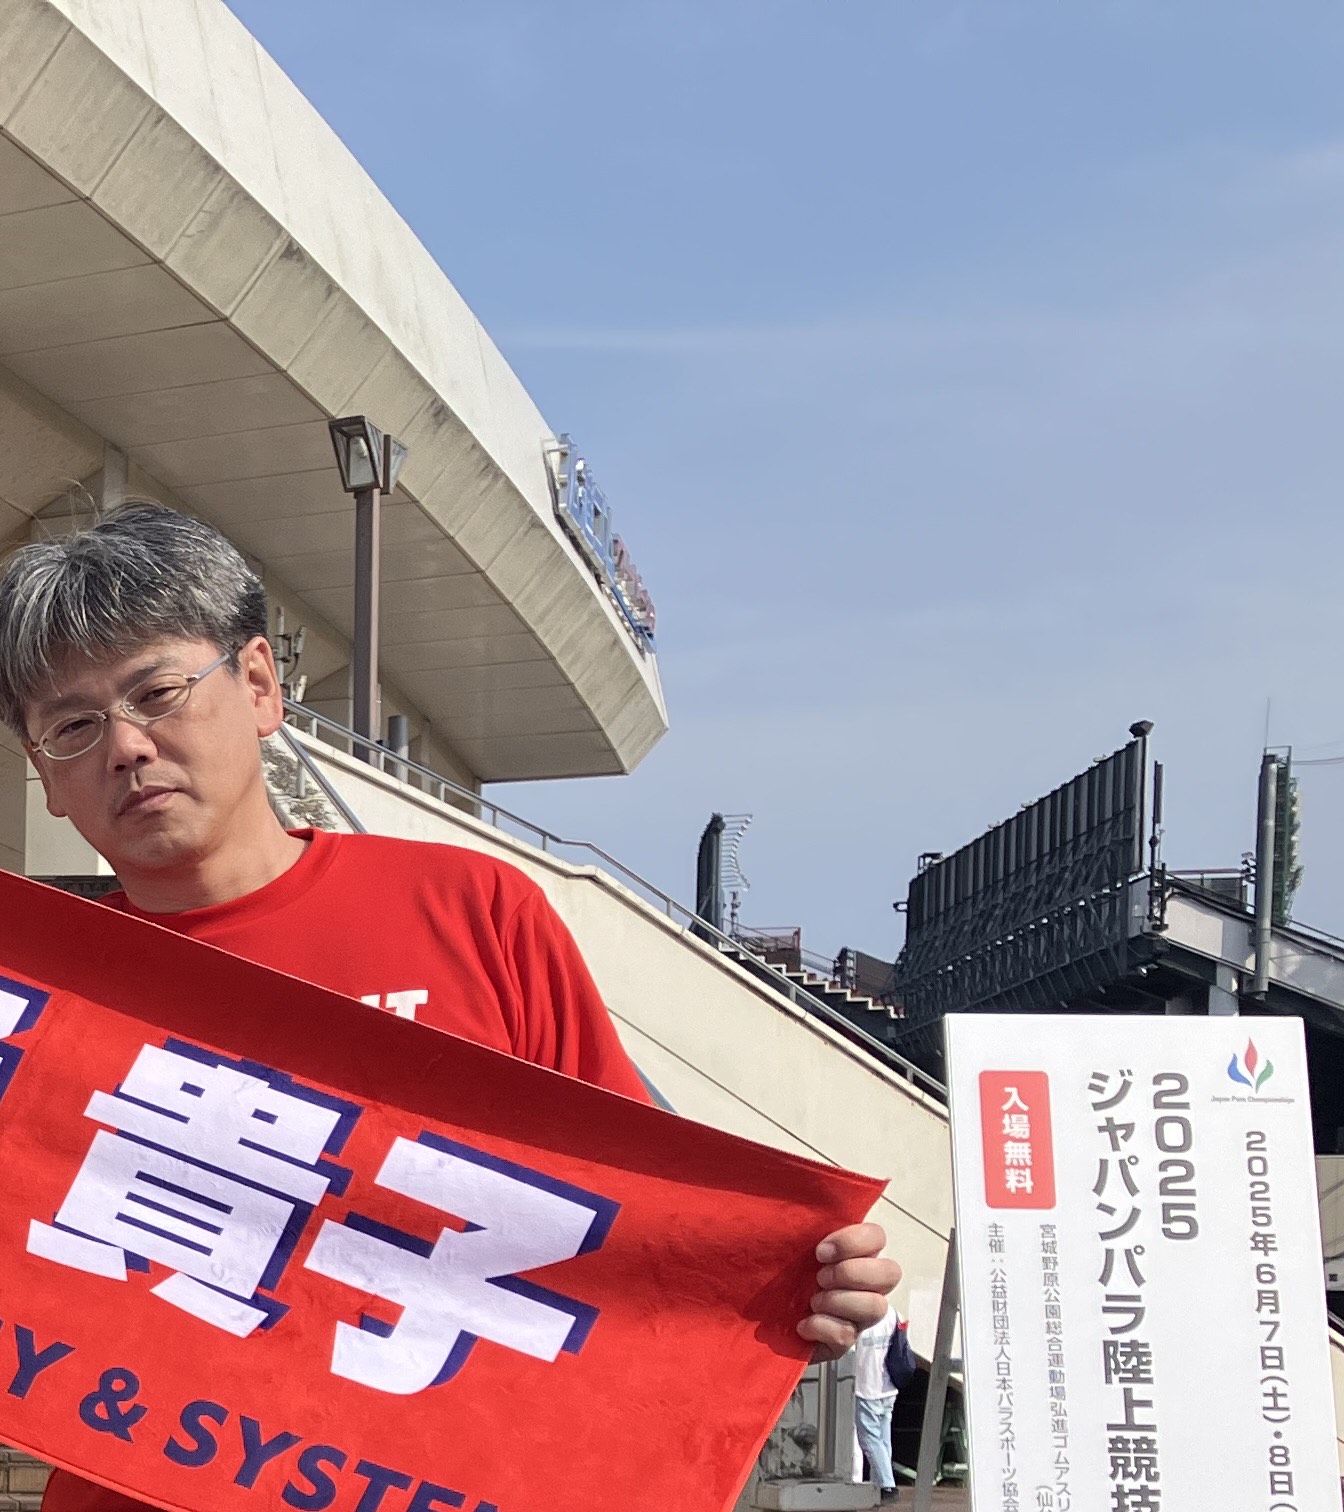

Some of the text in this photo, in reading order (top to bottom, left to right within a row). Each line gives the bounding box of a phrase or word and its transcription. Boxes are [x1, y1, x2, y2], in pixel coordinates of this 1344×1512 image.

[1001, 1086, 1035, 1195] 入場無料
[1152, 1072, 1199, 1241] 2025
[25, 1037, 620, 1396] 貴子
[78, 1366, 148, 1442] &
